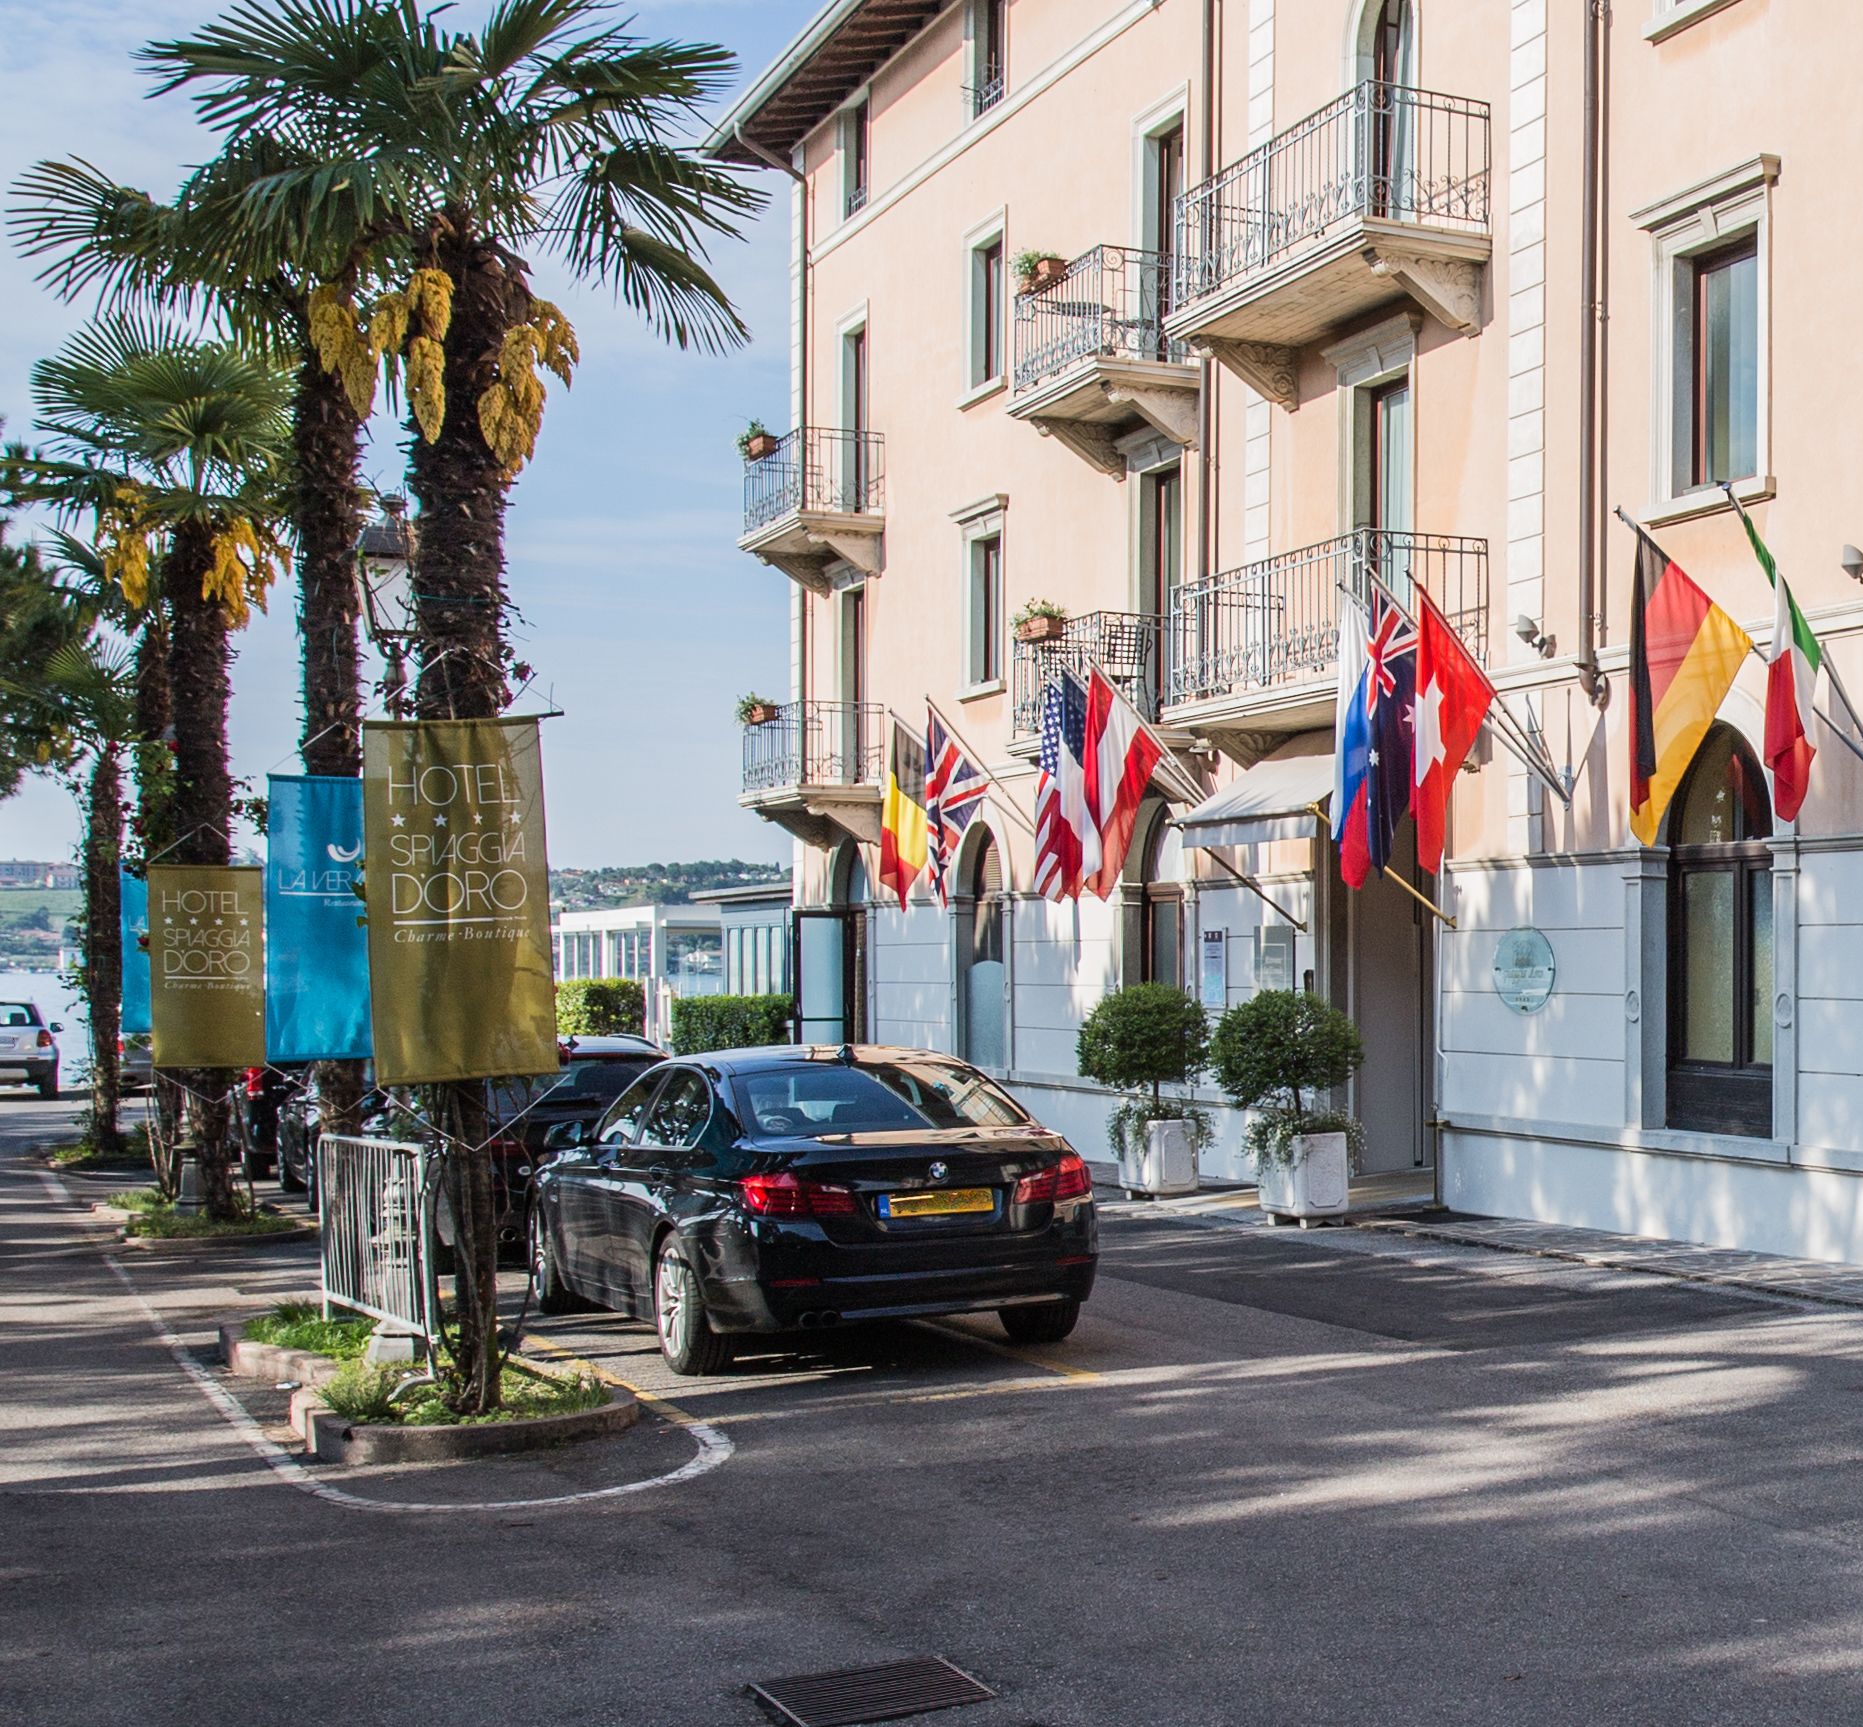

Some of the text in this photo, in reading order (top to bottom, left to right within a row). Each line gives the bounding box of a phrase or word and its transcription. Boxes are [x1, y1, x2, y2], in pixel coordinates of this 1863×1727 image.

[388, 763, 521, 807] HOTEL
[390, 831, 526, 867] SPIAGGIA
[278, 869, 306, 890] LA
[391, 869, 528, 914] D'ORO
[161, 889, 249, 915] HOTEL
[162, 928, 250, 948] SPIAGGIA
[163, 949, 250, 974] D'ORO
